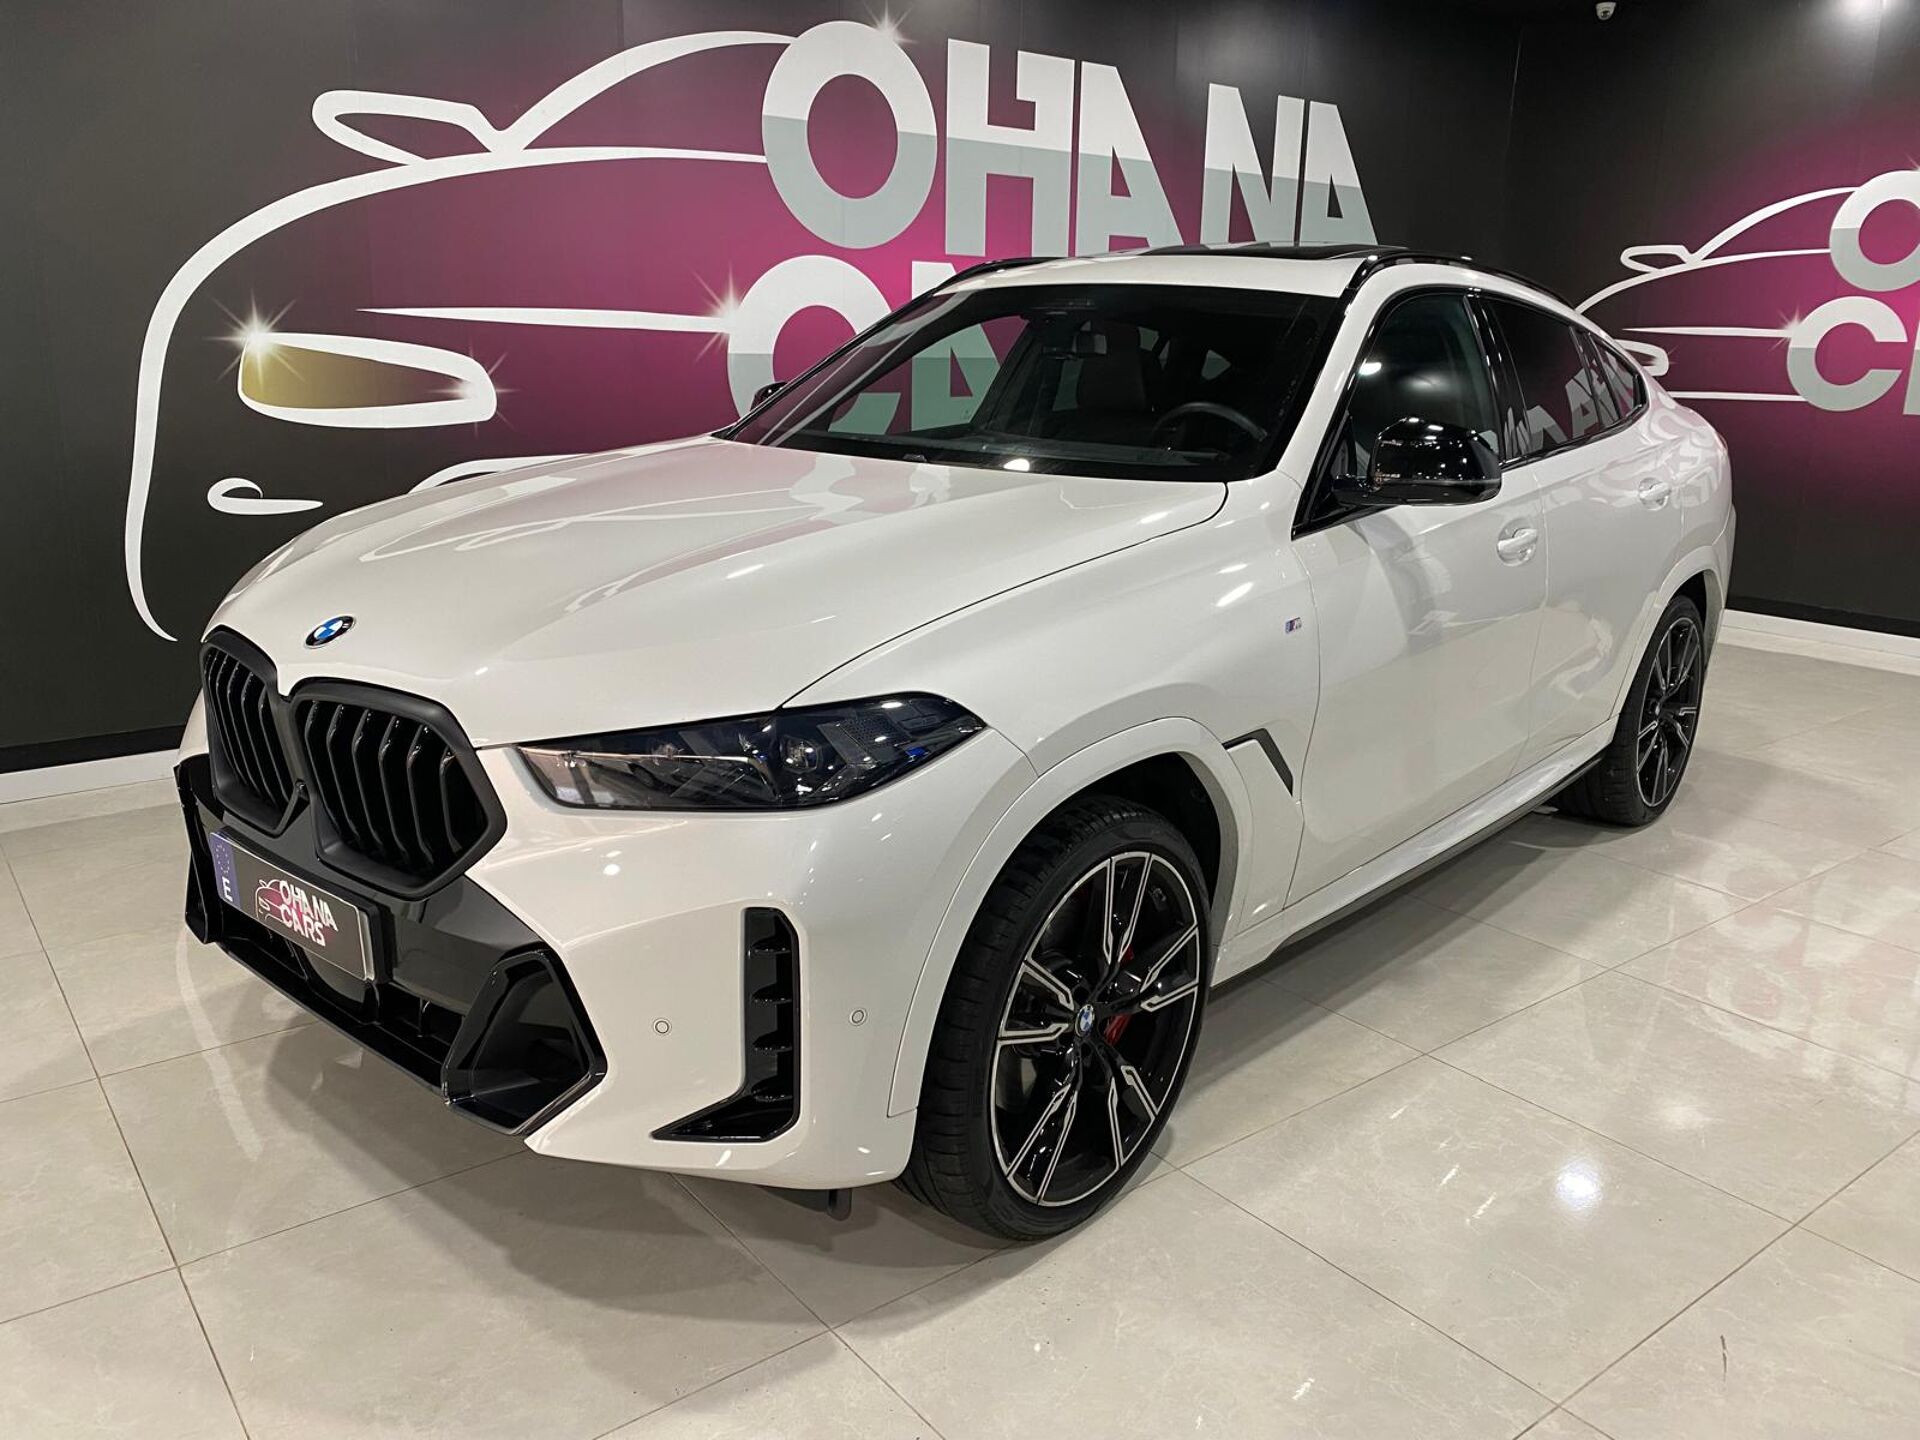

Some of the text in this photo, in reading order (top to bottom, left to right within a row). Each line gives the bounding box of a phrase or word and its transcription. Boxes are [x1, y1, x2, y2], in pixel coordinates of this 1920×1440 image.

[221, 876, 234, 902] E
[279, 880, 339, 932] OHANA
[279, 905, 326, 947] CARS
